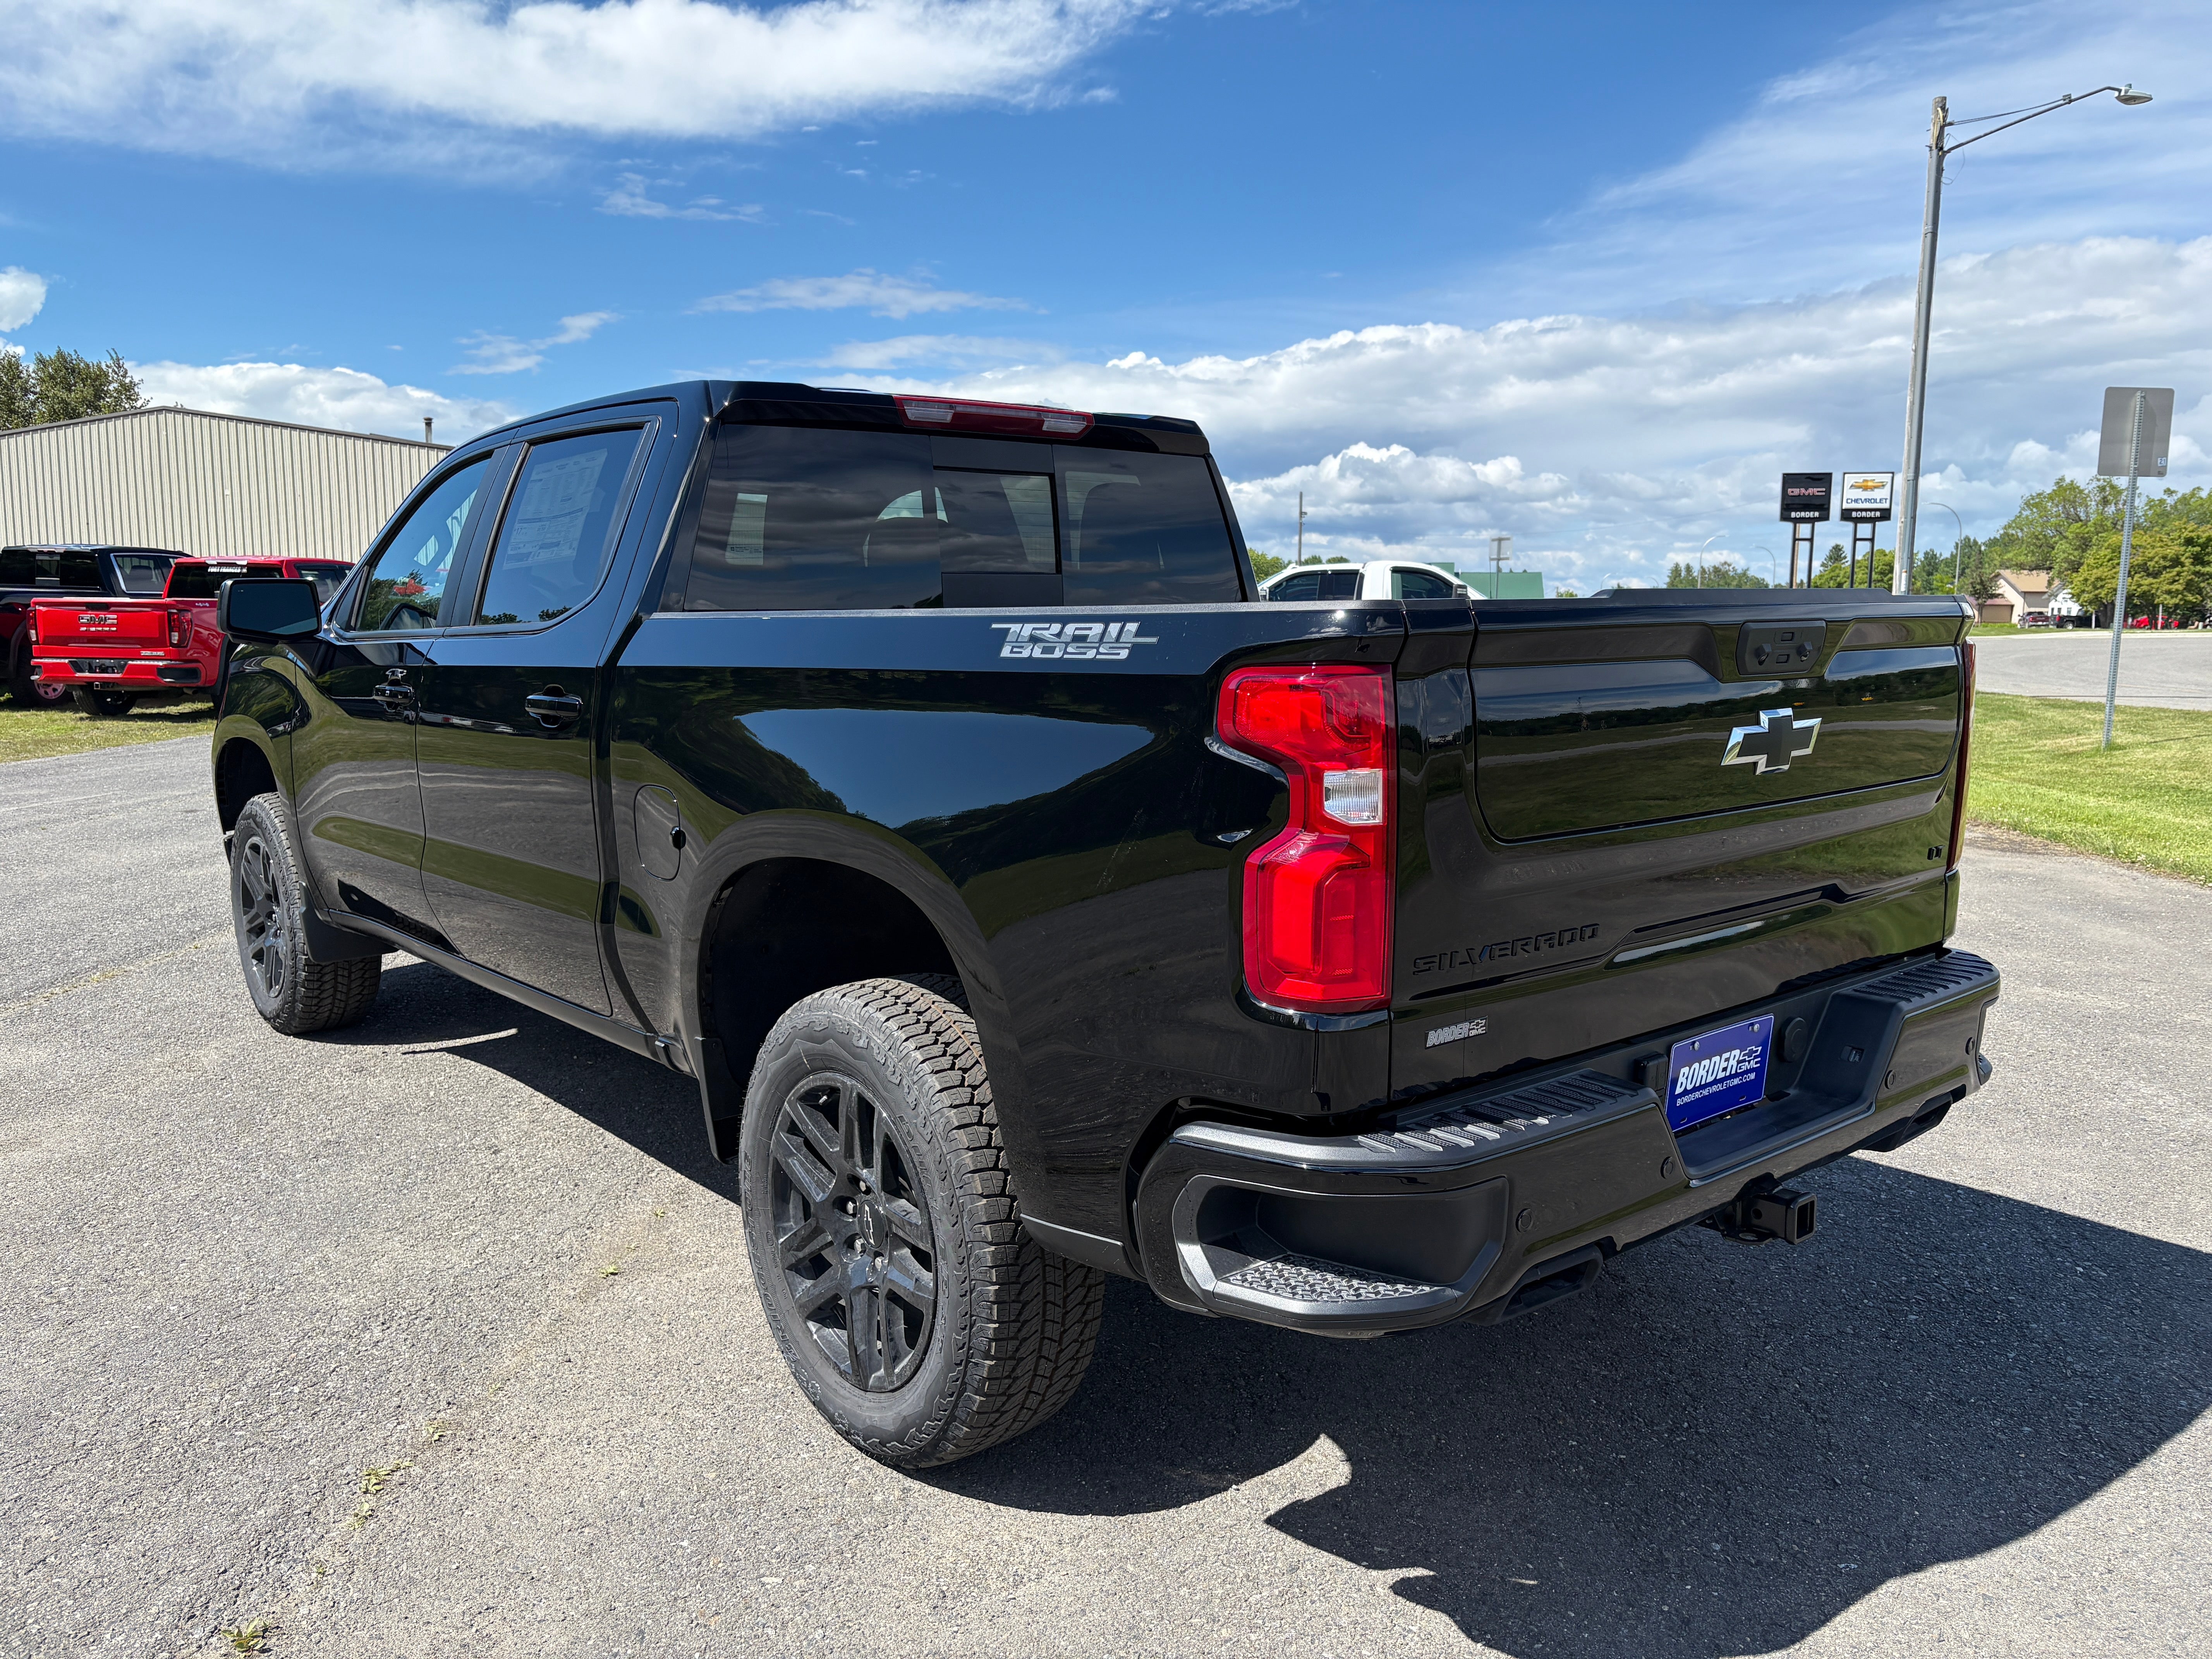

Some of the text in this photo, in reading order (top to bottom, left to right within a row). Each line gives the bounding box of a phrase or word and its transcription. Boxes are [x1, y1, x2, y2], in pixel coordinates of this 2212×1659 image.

[1788, 488, 1826, 496] GMC
[78, 615, 117, 624] GMC
[990, 622, 1159, 644] TRAIL
[1000, 642, 1133, 659] BOSS
[1413, 923, 1600, 975] SILVERADO
[1427, 1022, 1470, 1047] BORDER
[1469, 1027, 1486, 1037] GMC
[1675, 1049, 1740, 1095] BORDER
[1737, 1058, 1761, 1073] GMC
[1676, 1072, 1755, 1106] BORDERCHEVROLETGMC.COM
[744, 1150, 800, 1362] BRIDGESTONE
